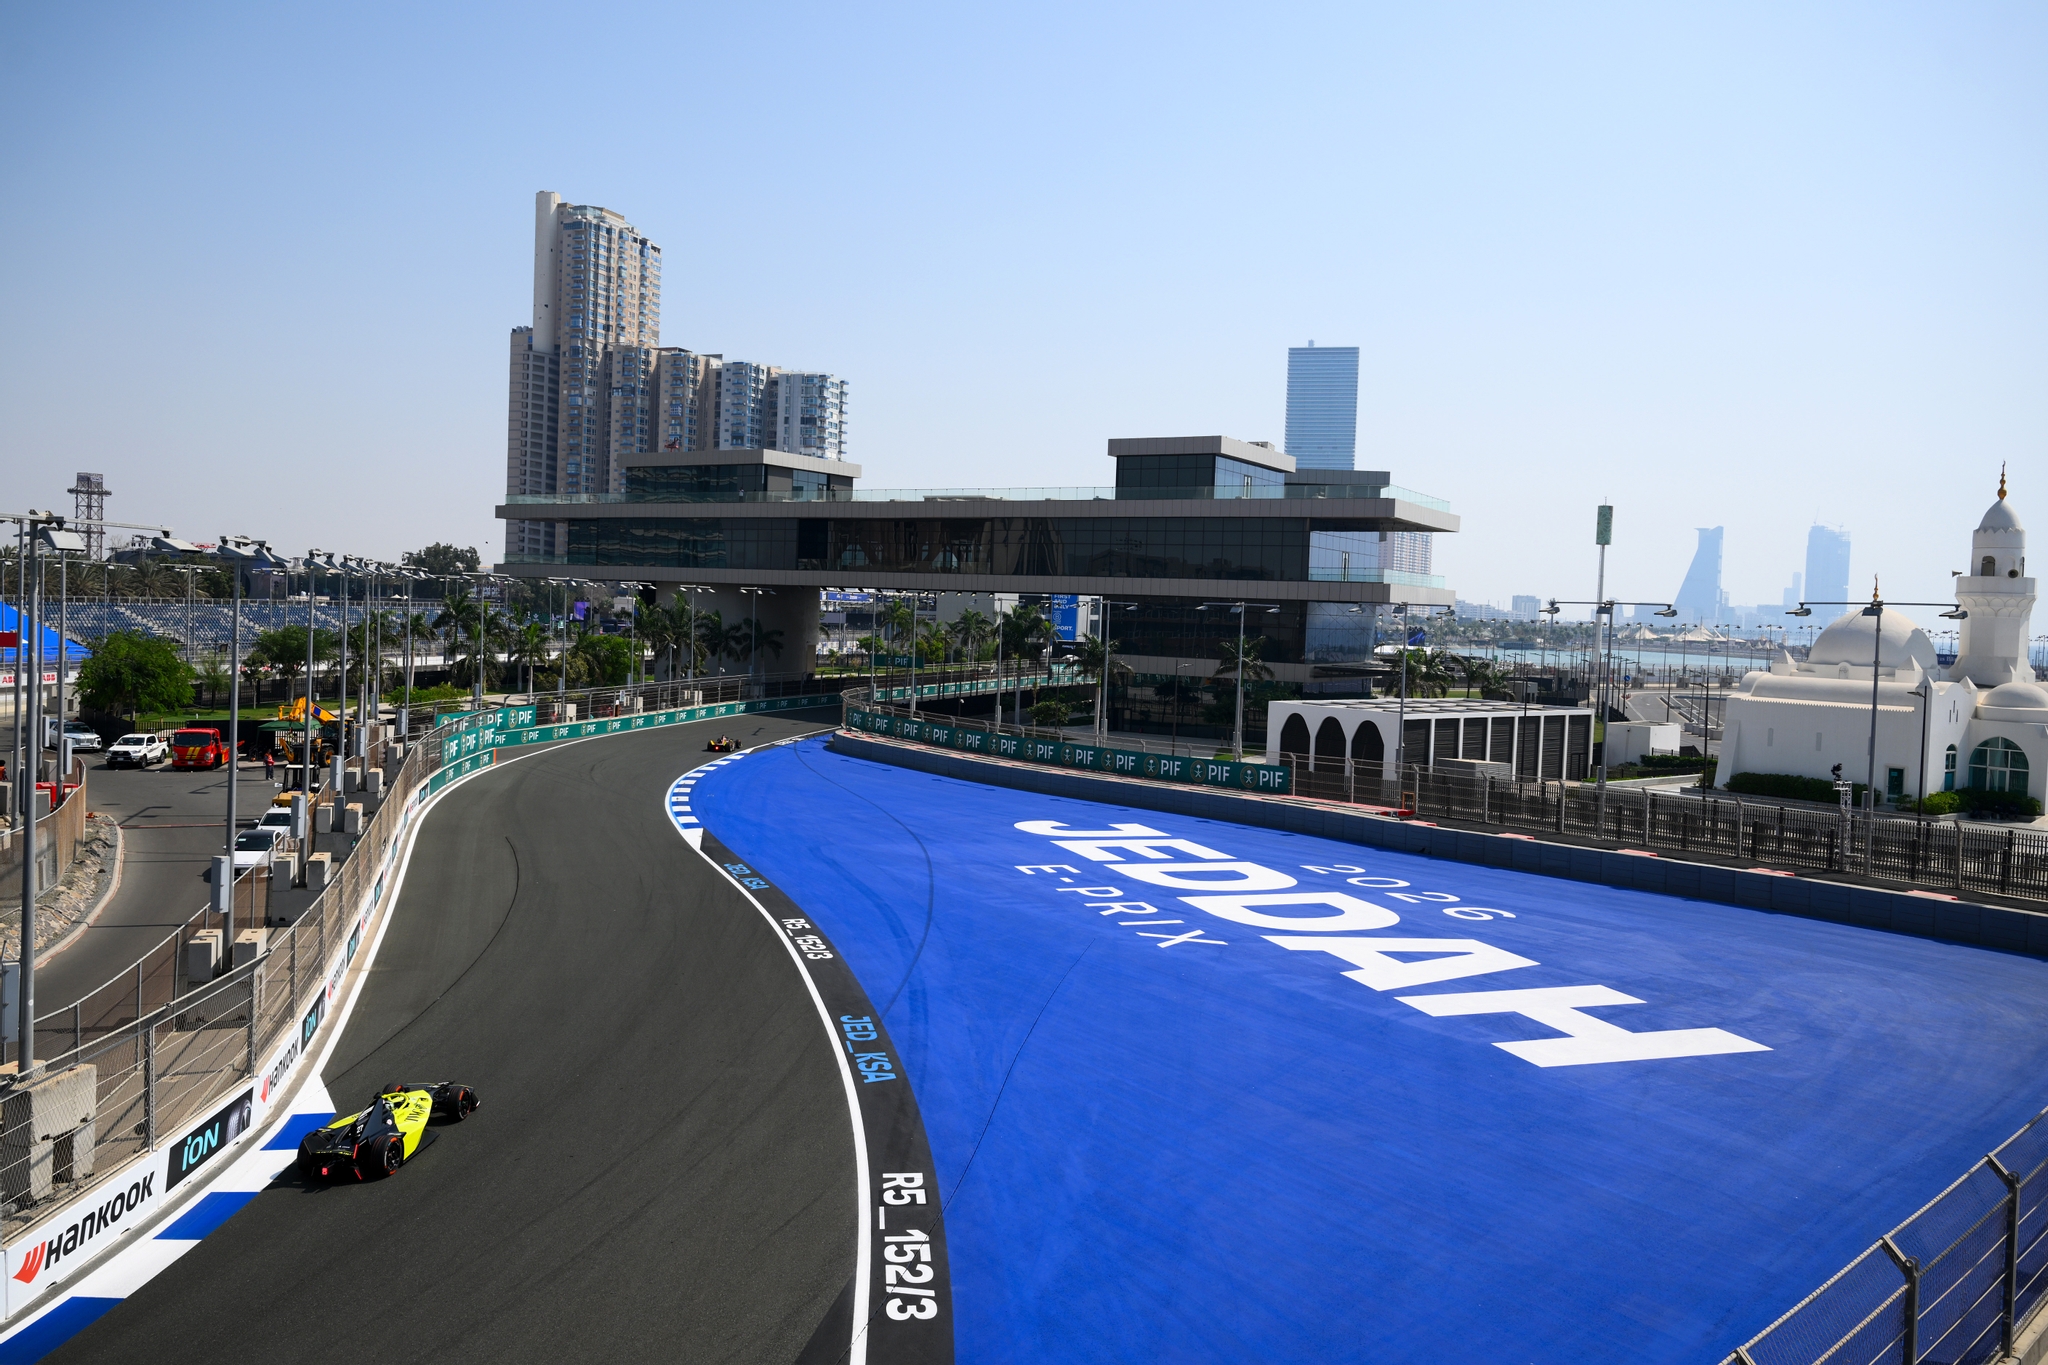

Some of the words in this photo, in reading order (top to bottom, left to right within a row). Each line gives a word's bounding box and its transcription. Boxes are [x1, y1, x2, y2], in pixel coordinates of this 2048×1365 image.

[449, 740, 459, 760] PIF
[465, 733, 477, 752] PIF
[484, 728, 495, 746] PIF
[494, 734, 507, 745] PIF
[528, 730, 540, 741] PIF
[559, 727, 570, 737] PIF
[586, 724, 597, 734] PIF
[612, 721, 622, 730] PIF
[518, 710, 533, 725] PIF
[875, 717, 889, 731] PIF
[903, 722, 919, 737] PIF
[933, 728, 949, 743] PIF
[966, 733, 982, 749] PIF
[1000, 739, 1018, 755] PIF
[1036, 744, 1055, 760] PIF
[1075, 749, 1095, 765] PIF
[1116, 754, 1137, 771] PIF
[1160, 759, 1182, 777] PIF
[1208, 764, 1231, 782] PIF
[1259, 770, 1284, 788] PIF
[1015, 864, 1229, 949] E-PRIX
[1299, 864, 1517, 922] 2026
[781, 918, 834, 960] R5_152/3
[1014, 820, 1775, 1069] JEDDAH
[840, 1015, 897, 1084] JED_KSA
[878, 1172, 938, 1321] R5_152/3
